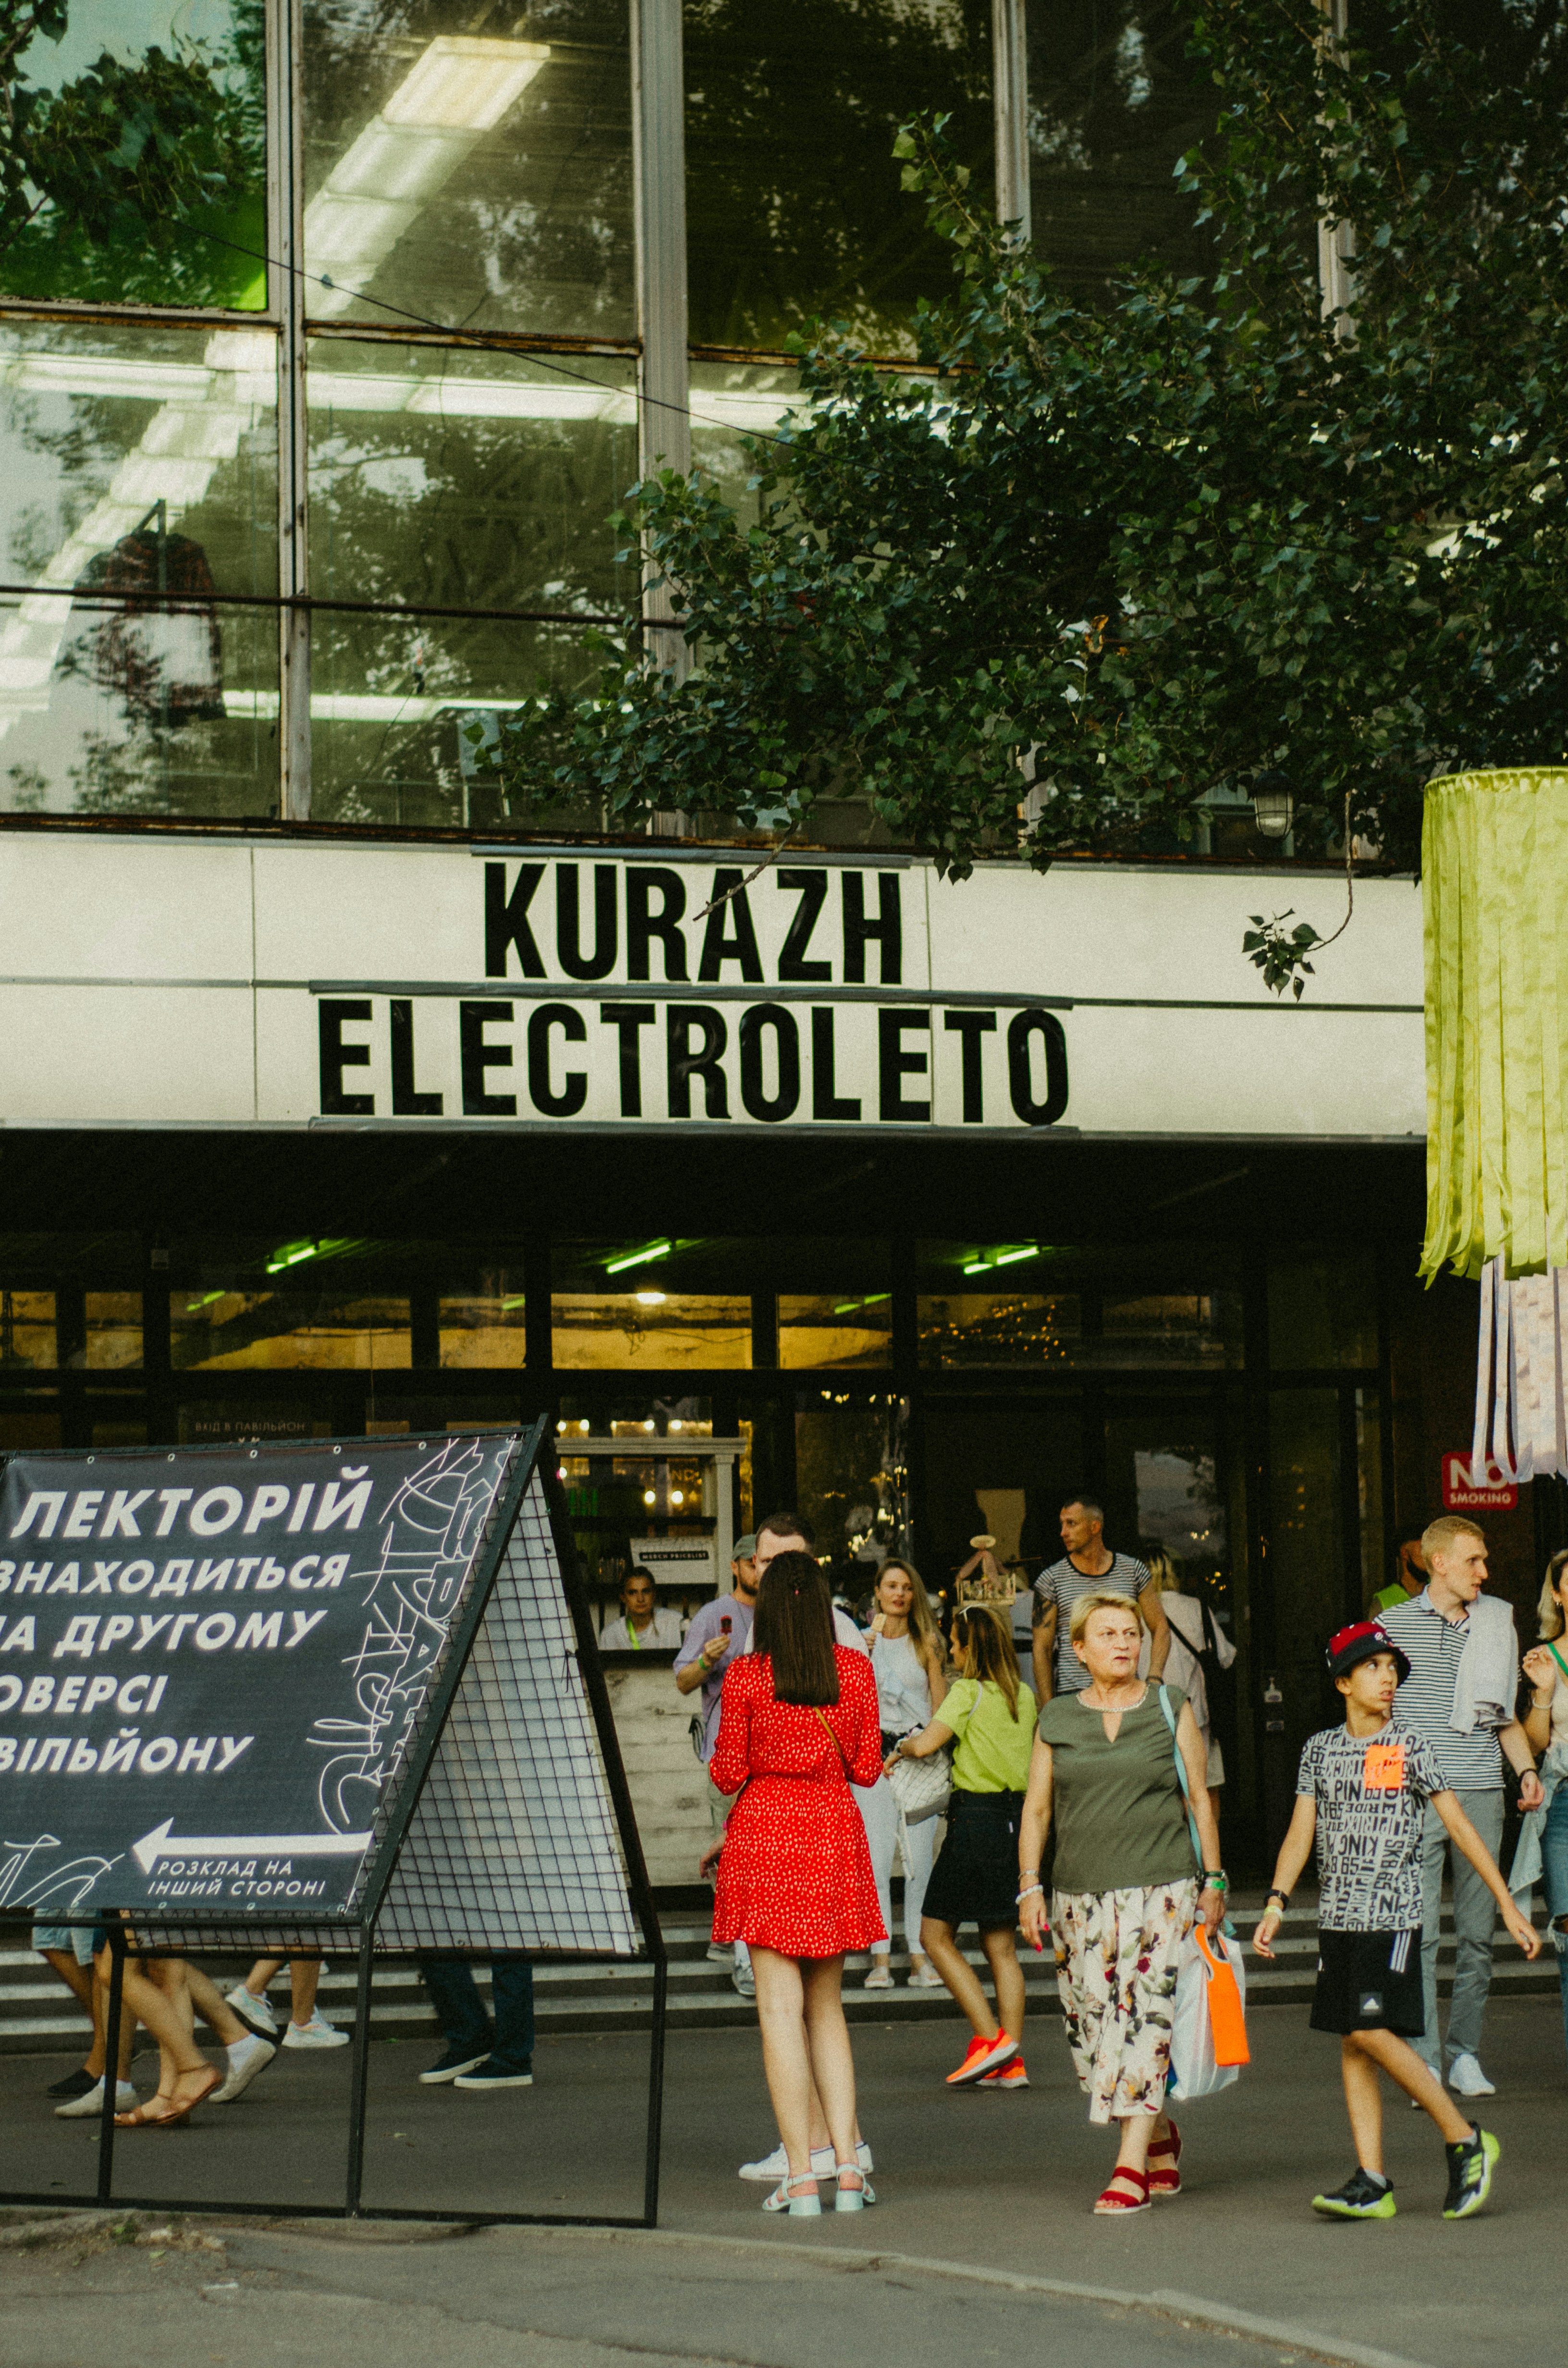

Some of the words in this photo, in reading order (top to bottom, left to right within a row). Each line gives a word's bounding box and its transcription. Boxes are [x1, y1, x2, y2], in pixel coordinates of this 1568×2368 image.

[485, 862, 902, 984] KURAZH
[318, 998, 1070, 1126] ELECTROLETO
[1450, 1458, 1508, 1490] NO
[10, 1466, 374, 1539] ЛЕКТОРІЙ
[1449, 1492, 1511, 1509] SMOKING
[0, 1615, 36, 1652] А
[53, 1610, 328, 1658] ДРУГОМУ
[147, 1878, 222, 1896] ІНШИЙ
[231, 1880, 325, 1896] СТОРОНІ
[157, 1860, 257, 1878] РОЗКЛАД
[264, 1860, 292, 1875] НА
